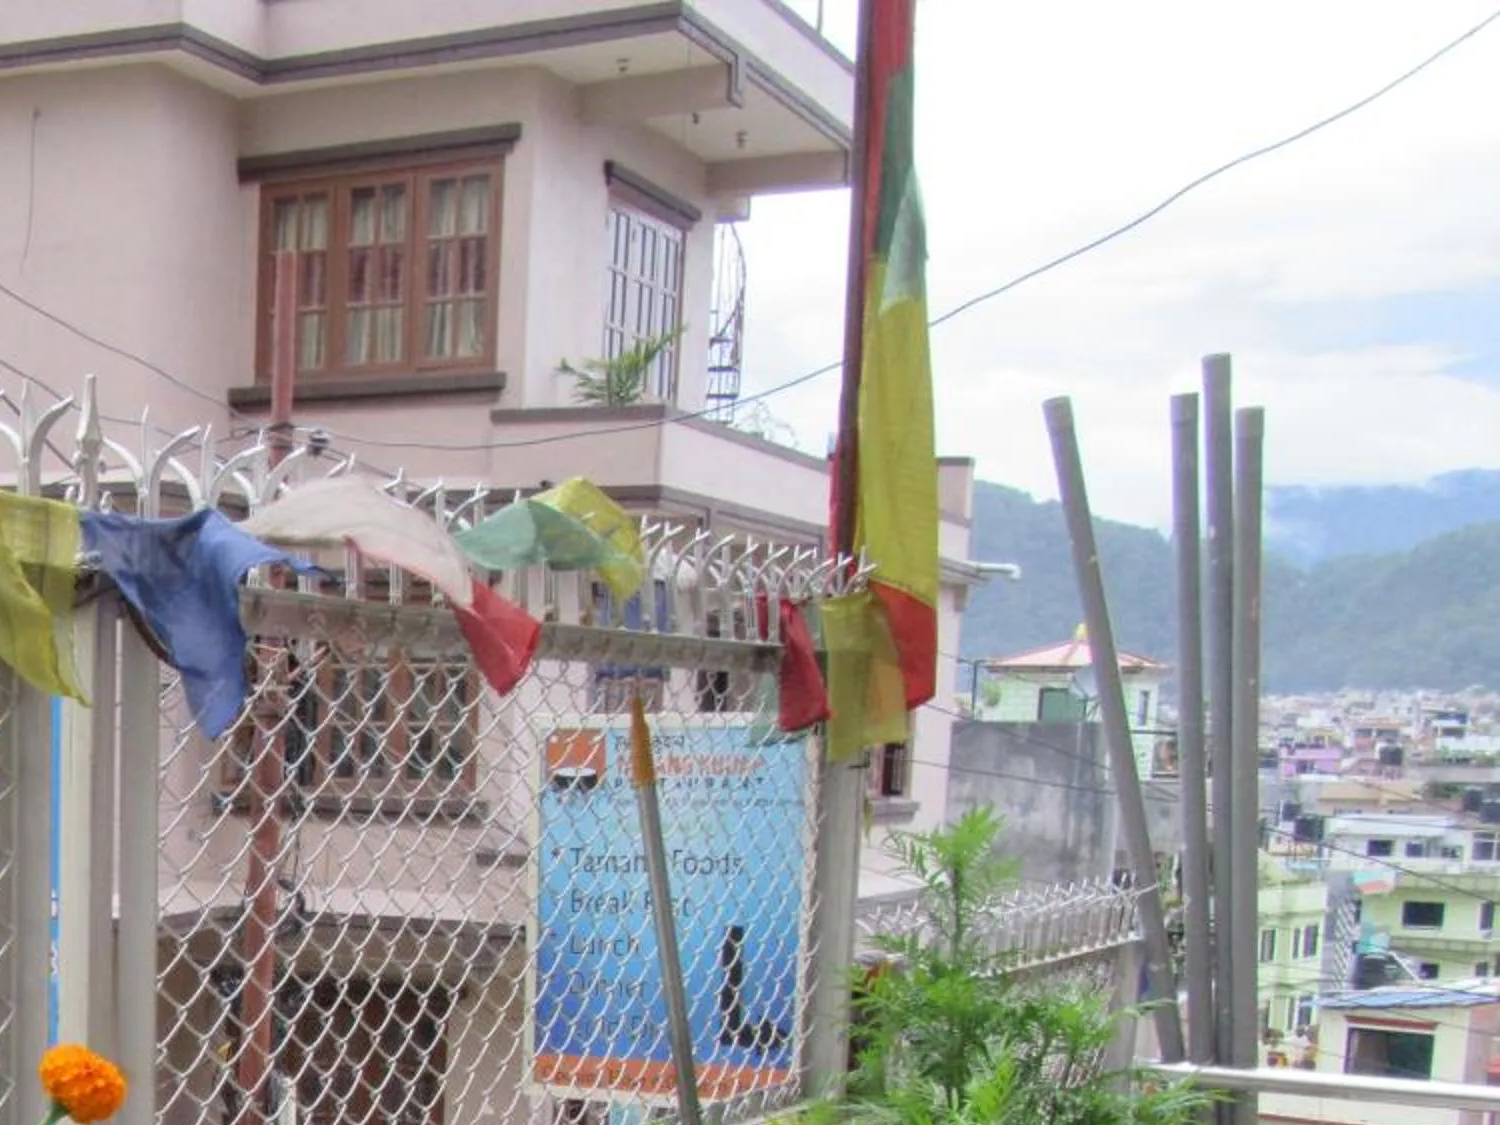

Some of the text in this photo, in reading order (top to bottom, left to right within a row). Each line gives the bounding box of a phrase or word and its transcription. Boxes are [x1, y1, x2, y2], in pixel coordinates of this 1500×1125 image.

[570, 847, 745, 876] Taman Foods
[570, 887, 633, 915] Break
[569, 933, 640, 957] Lunch
